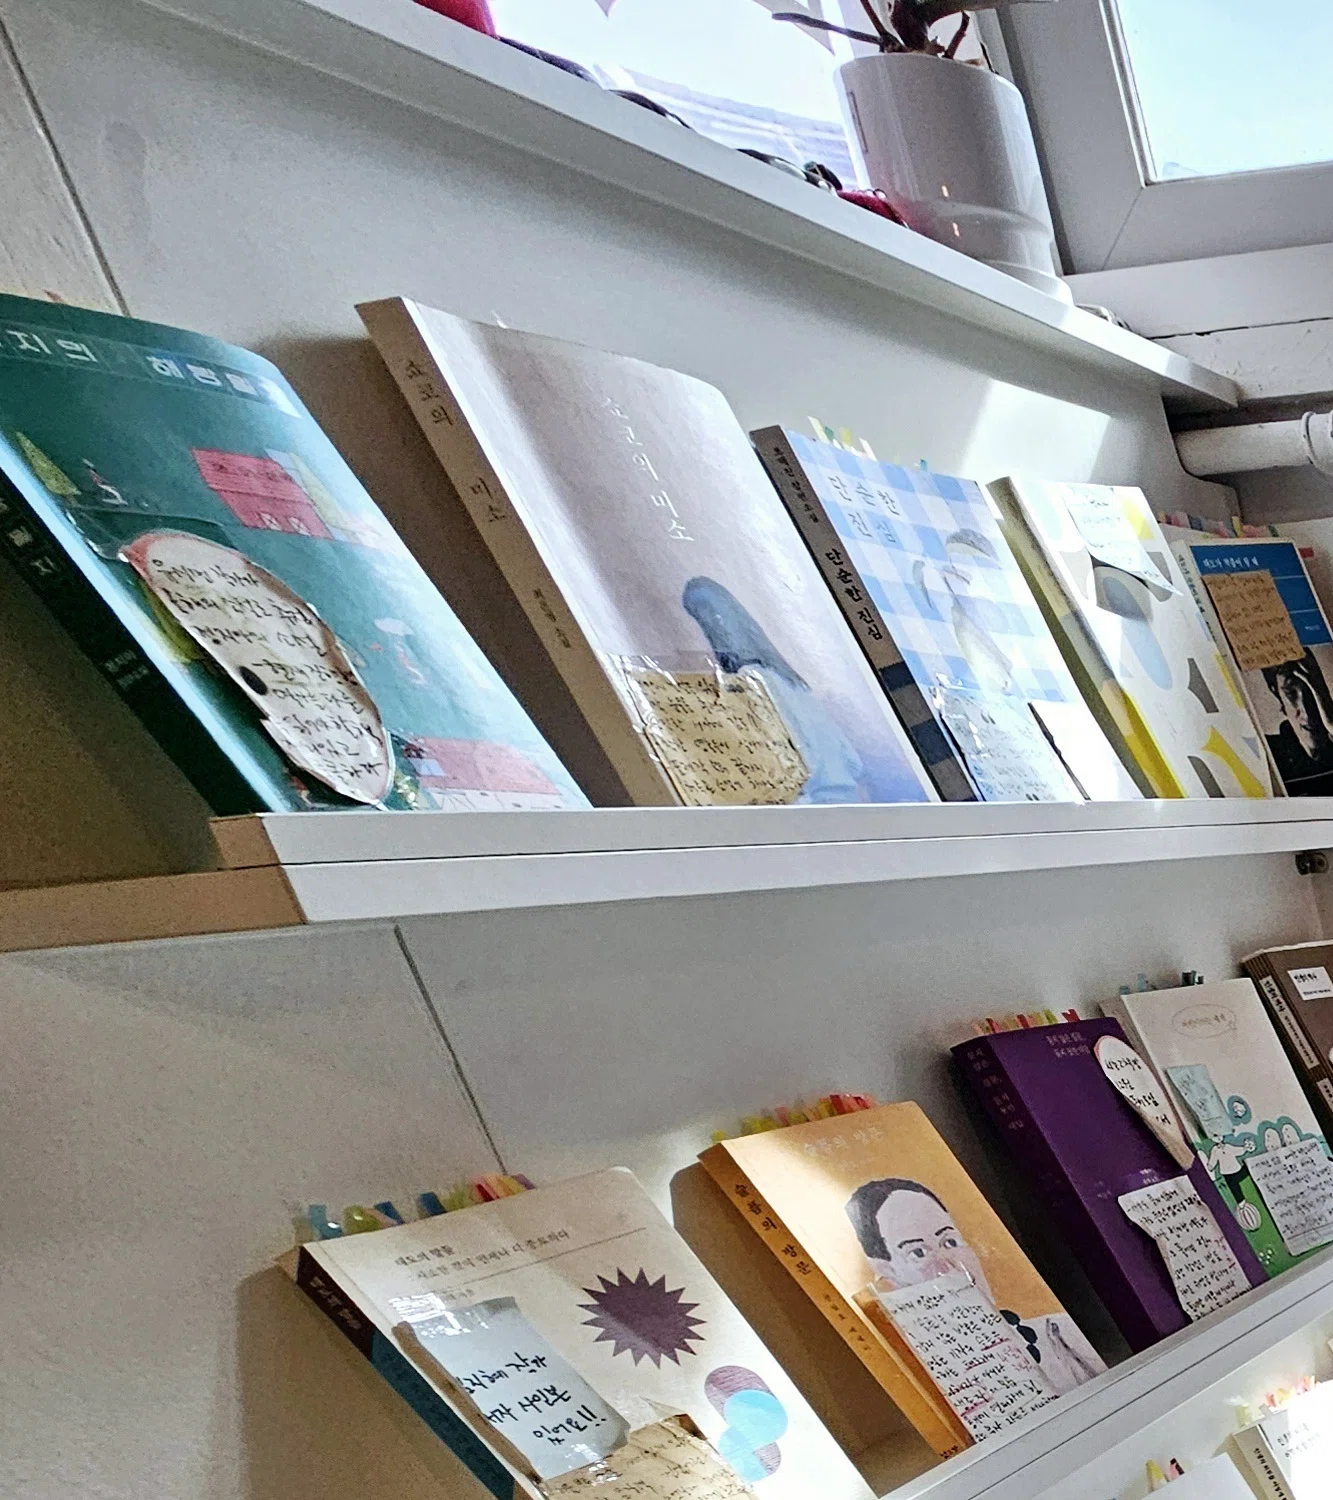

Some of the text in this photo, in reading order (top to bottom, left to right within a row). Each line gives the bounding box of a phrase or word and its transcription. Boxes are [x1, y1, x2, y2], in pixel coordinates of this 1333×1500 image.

[401, 358, 508, 525] 쇼코의 미소
[602, 394, 696, 543] 쇼코의 미소
[825, 473, 902, 518] 단순한
[847, 510, 898, 545] 진심
[825, 547, 885, 642] 단순한 진심
[732, 1183, 813, 1277] 슬픔의 방문
[463, 1352, 548, 1395] 지혜 작가
[532, 1405, 607, 1447] 있어요!!
